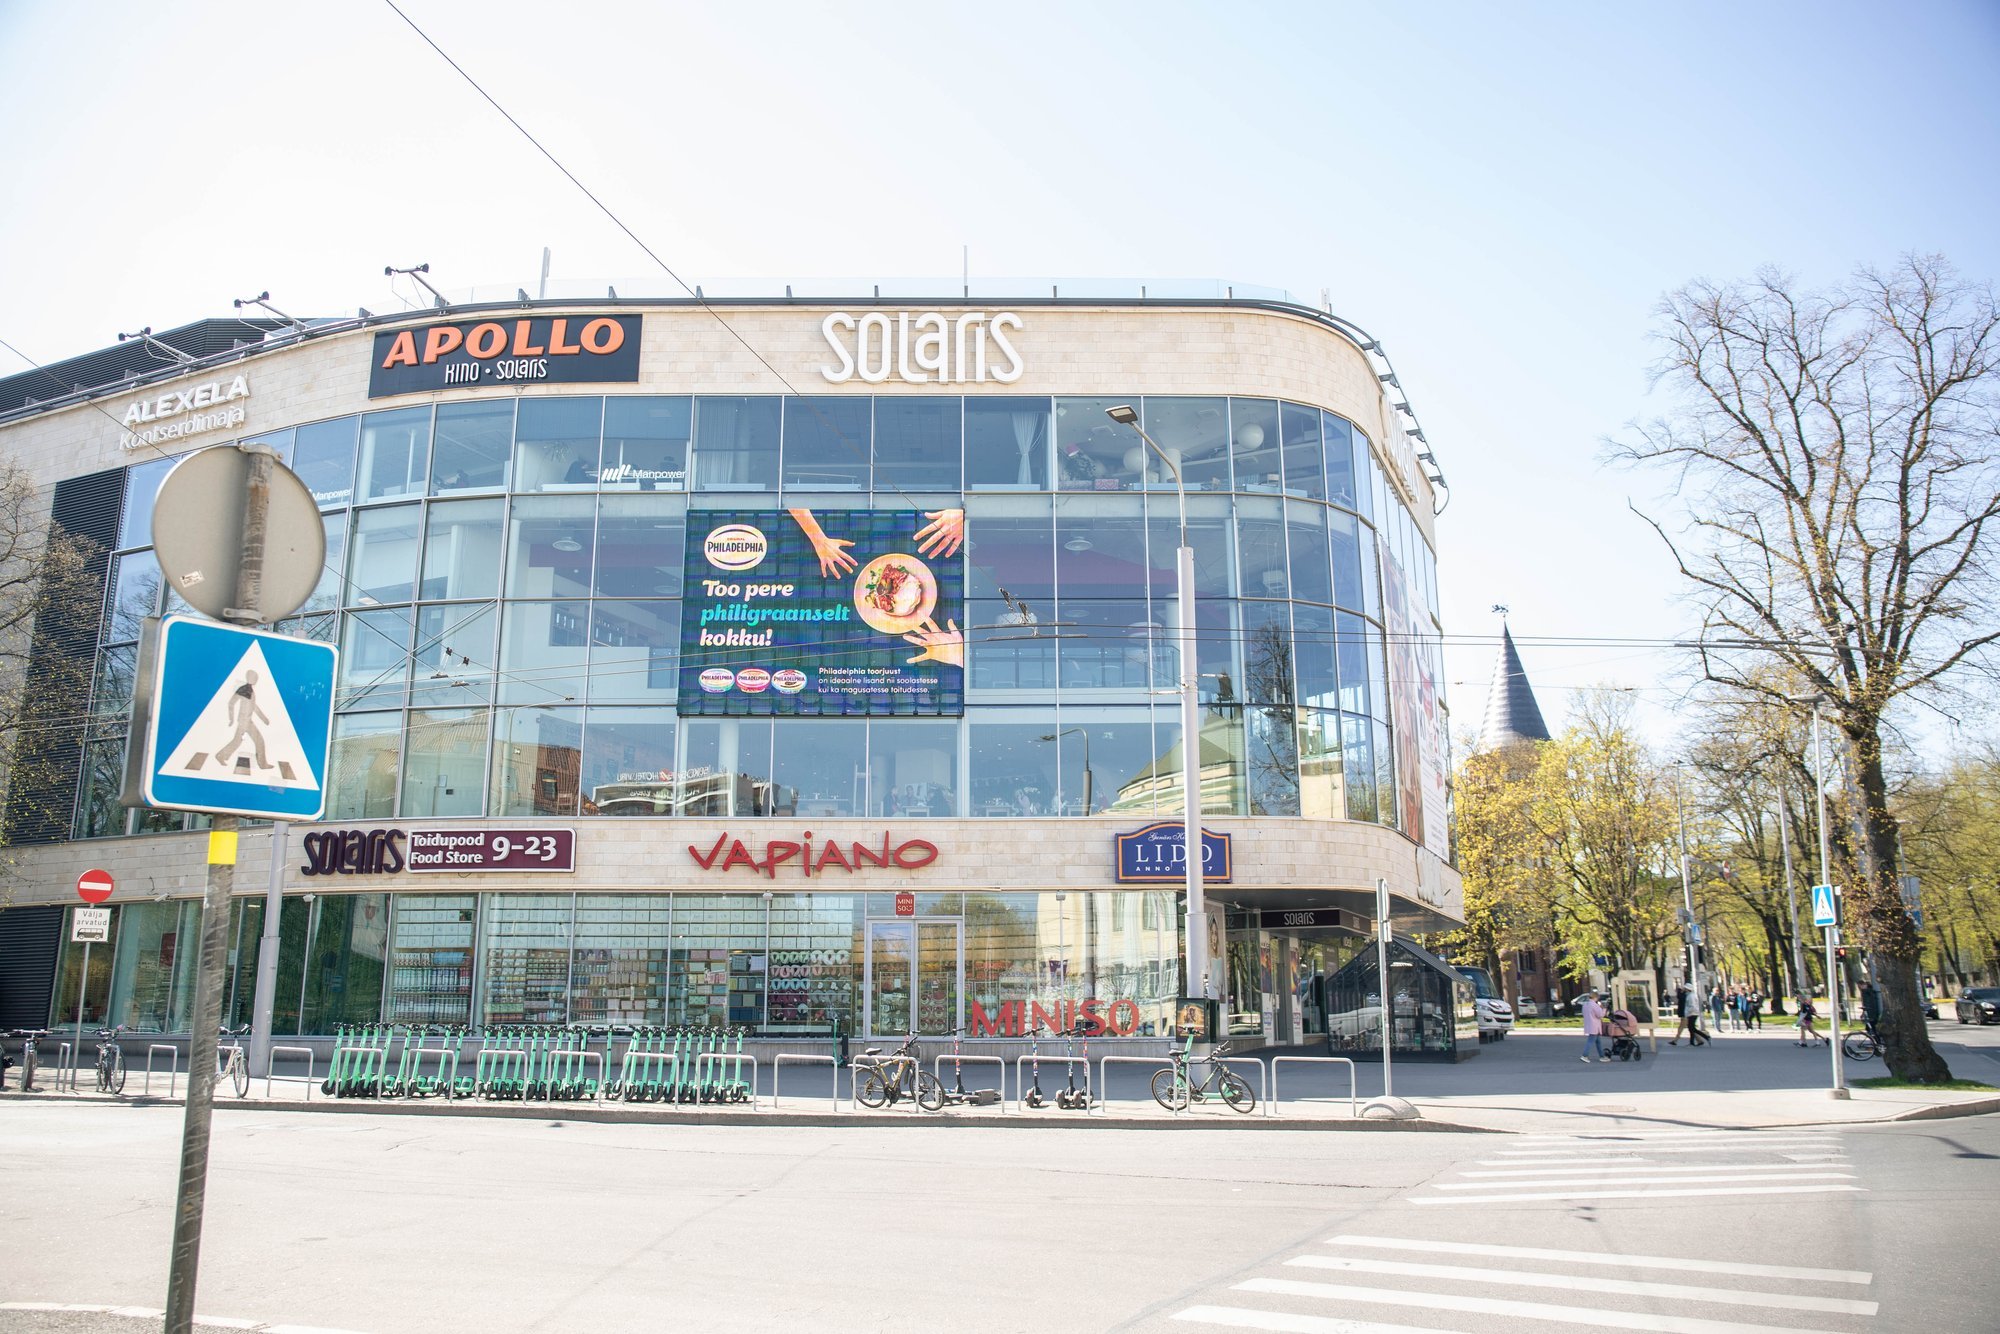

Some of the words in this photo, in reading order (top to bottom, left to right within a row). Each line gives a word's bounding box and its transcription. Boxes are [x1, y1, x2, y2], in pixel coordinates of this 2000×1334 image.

[382, 318, 625, 369] APOLLO
[445, 362, 479, 384] KINO
[122, 375, 250, 427] ALEXELA
[119, 405, 245, 450] Kontserdimaja
[632, 469, 686, 480] Manpower
[707, 541, 764, 553] PHILADELPHIA
[702, 579, 741, 597] Too
[744, 583, 794, 602] pere
[700, 603, 850, 627] philigraanselt
[699, 628, 773, 646] kokku!
[818, 667, 866, 676] Philadelphia
[867, 668, 901, 676] toorjuust
[411, 833, 485, 850] Toidupood
[410, 851, 444, 864] Food
[445, 851, 484, 864] Store
[688, 830, 939, 880] VAPIANO
[82, 910, 103, 919] Välja
[971, 999, 1140, 1037] MINISO
